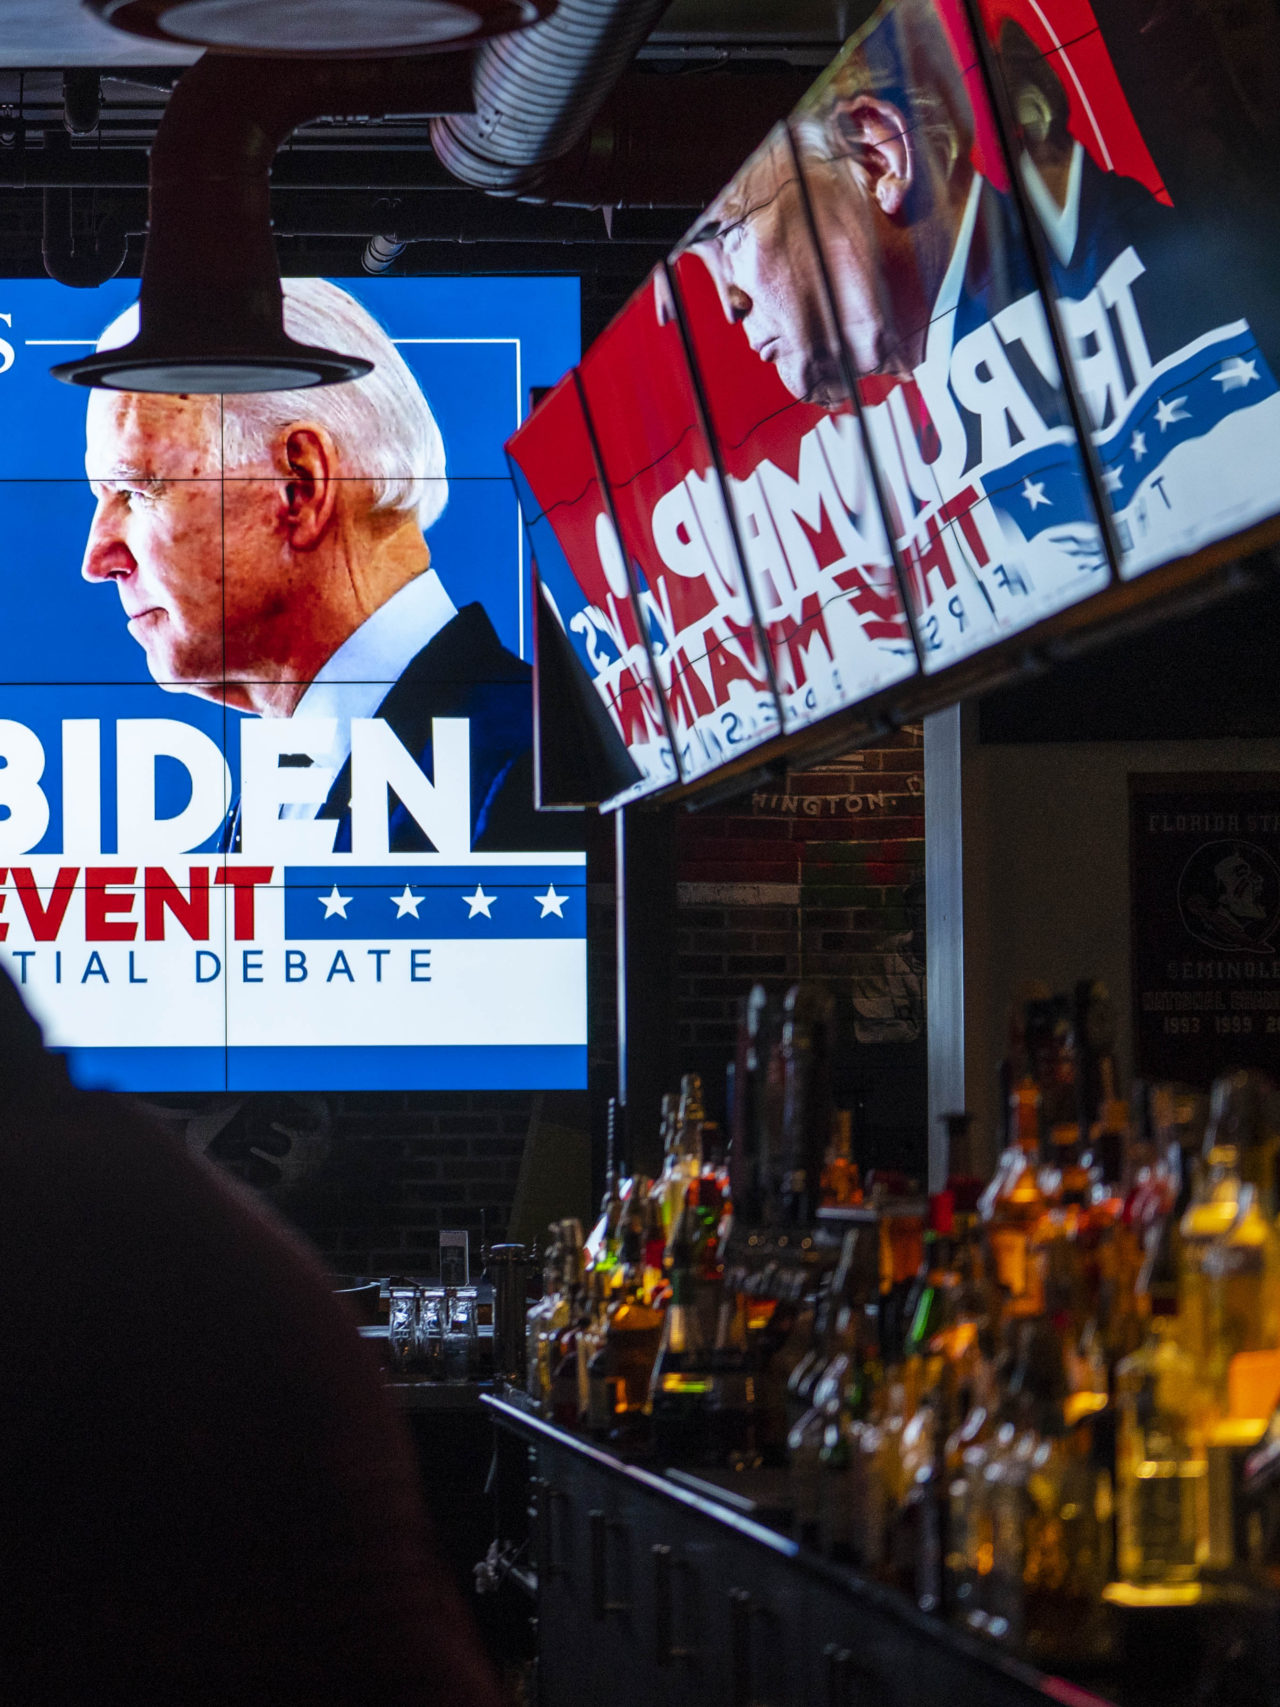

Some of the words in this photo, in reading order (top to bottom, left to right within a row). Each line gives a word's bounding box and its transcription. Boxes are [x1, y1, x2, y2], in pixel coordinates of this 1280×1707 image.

[1148, 813, 1239, 832] FLORIDA
[195, 948, 433, 984] DEBATE
[1166, 960, 1280, 979] SEMINOLE
[1163, 1015, 1201, 1034] 1993
[1214, 1015, 1253, 1034] 1999
